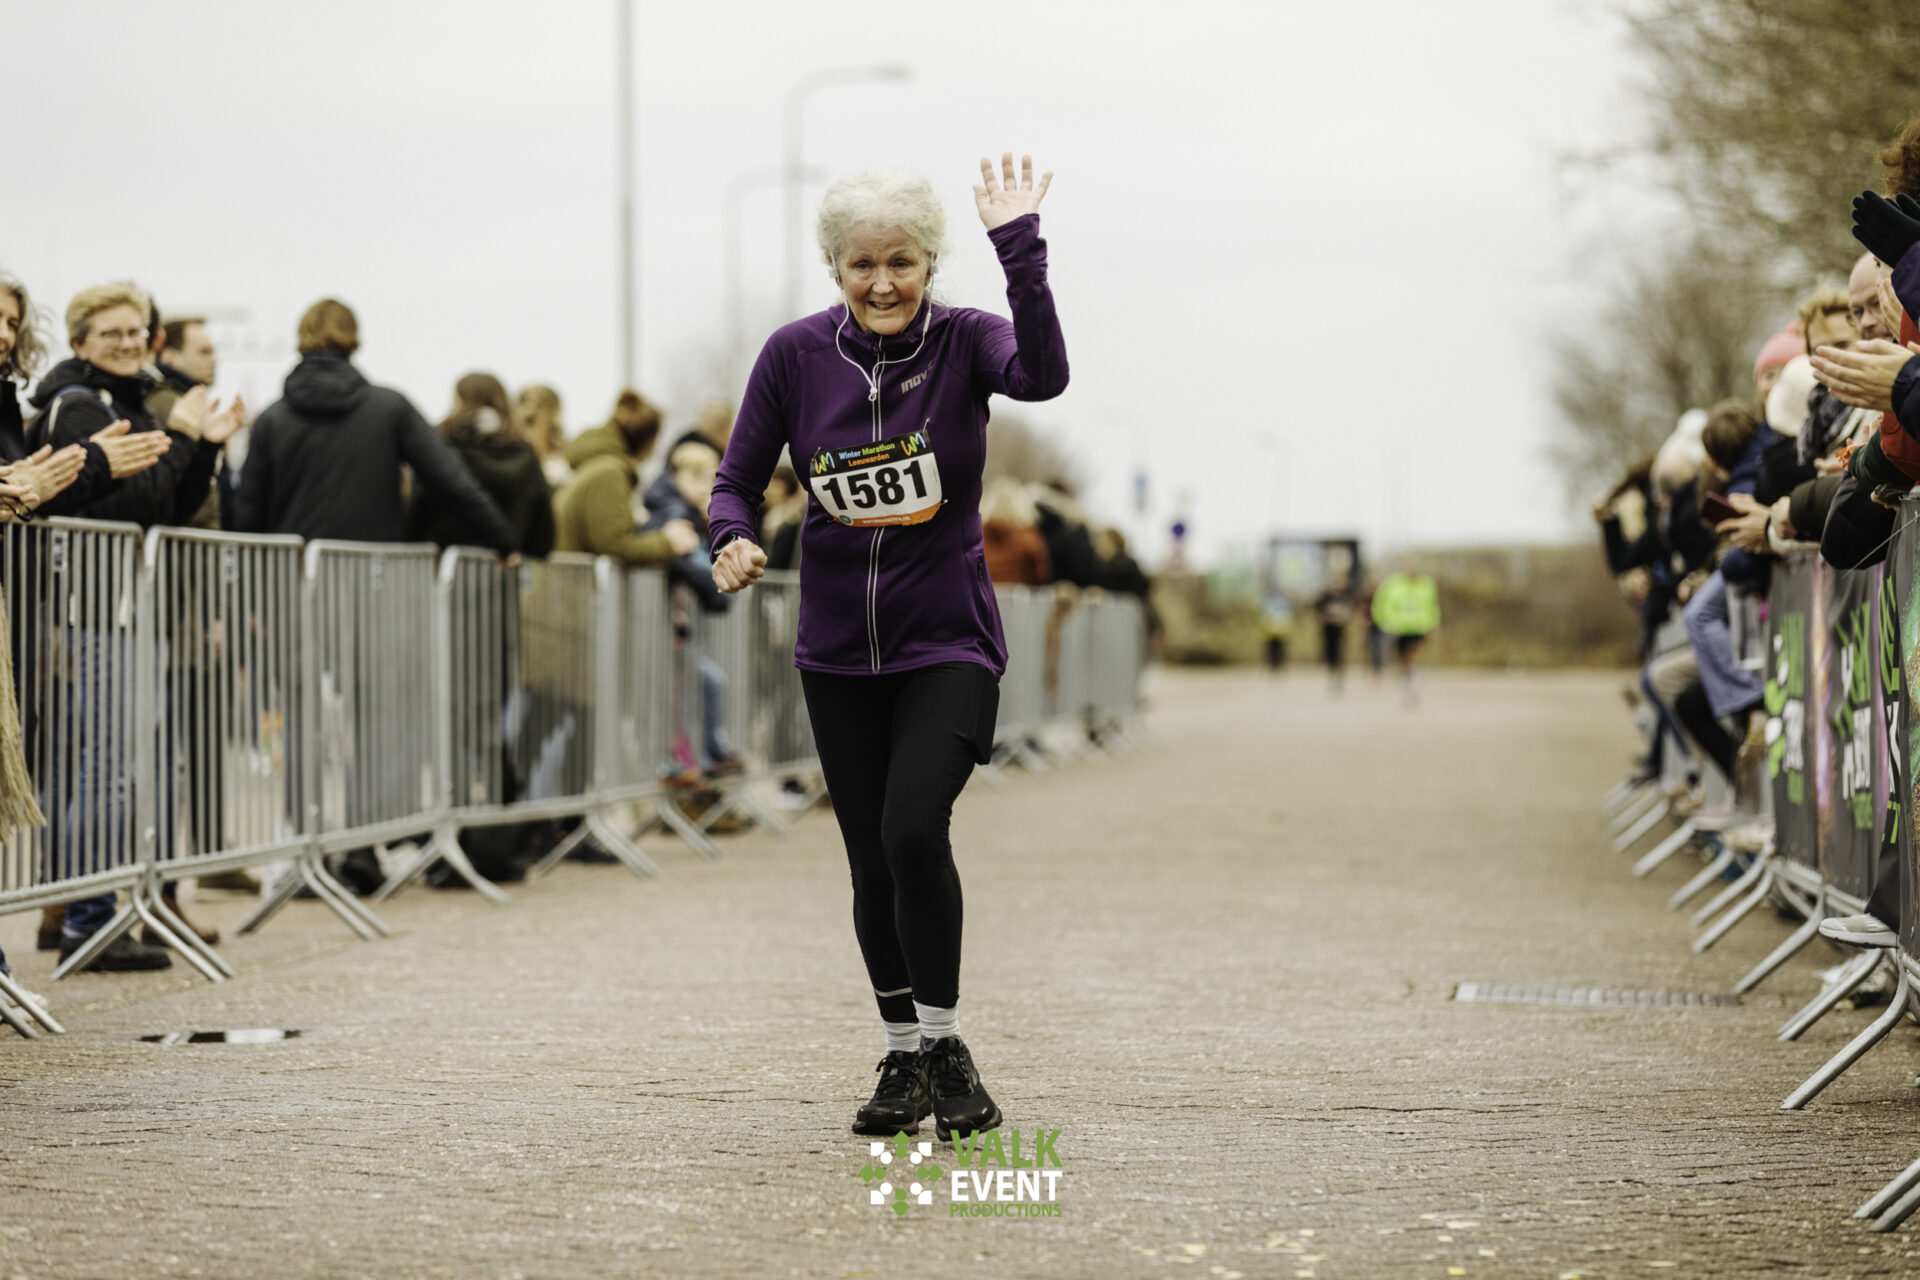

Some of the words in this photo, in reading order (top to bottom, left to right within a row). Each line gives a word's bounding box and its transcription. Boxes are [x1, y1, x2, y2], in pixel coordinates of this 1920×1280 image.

[839, 450, 861, 460] Winter
[862, 443, 895, 456] Marathon
[848, 453, 890, 467] Leeuwarden
[822, 460, 927, 510] 1581
